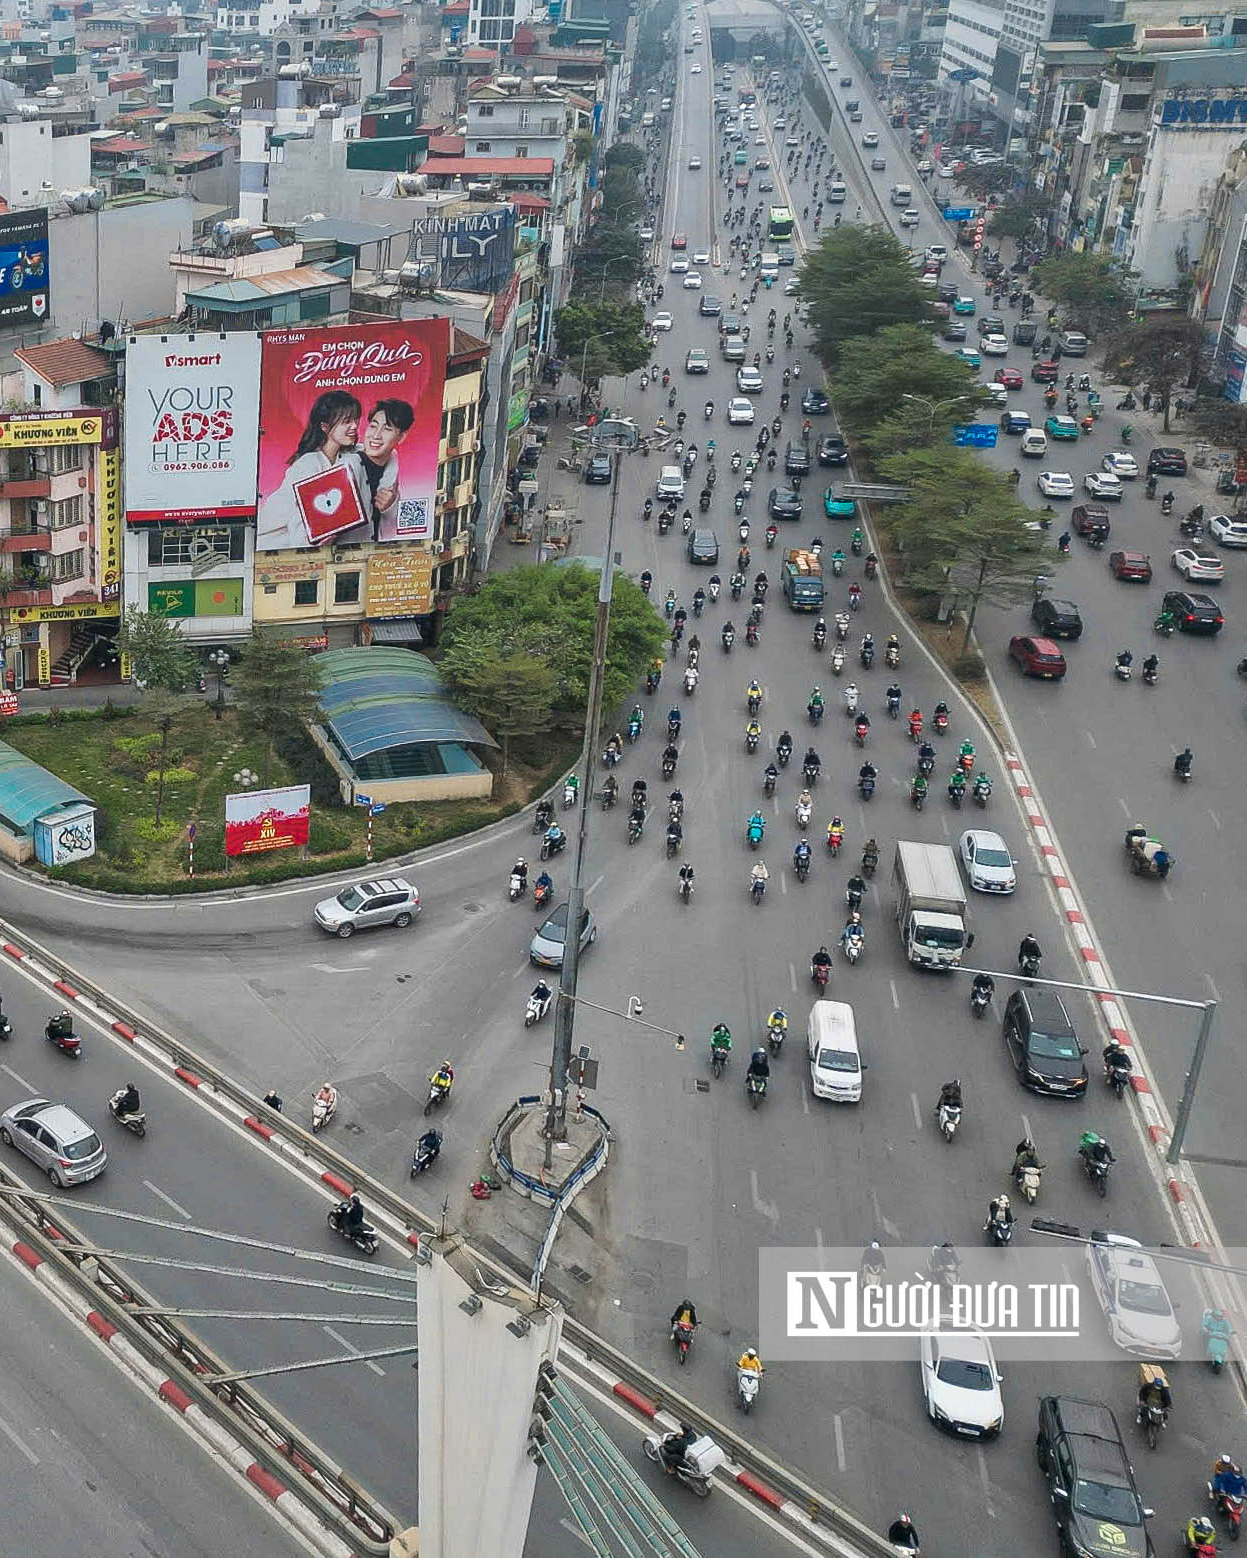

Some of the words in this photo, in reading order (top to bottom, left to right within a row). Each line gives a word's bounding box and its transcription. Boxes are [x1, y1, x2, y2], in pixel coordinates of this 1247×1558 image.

[416, 234, 498, 259] LILY
[322, 343, 336, 352] EM
[338, 341, 364, 352] CHỌN
[315, 377, 334, 388] ANH
[337, 375, 363, 388] CHỌN
[391, 373, 406, 383] EM
[148, 386, 234, 426] YOUR
[14, 428, 53, 440] KHƯƠNG
[56, 425, 78, 438] VIÊN
[153, 410, 234, 443] ADS
[163, 461, 230, 471] 0962.906.086
[104, 583, 119, 595] 341
[260, 828, 276, 839] XIV
